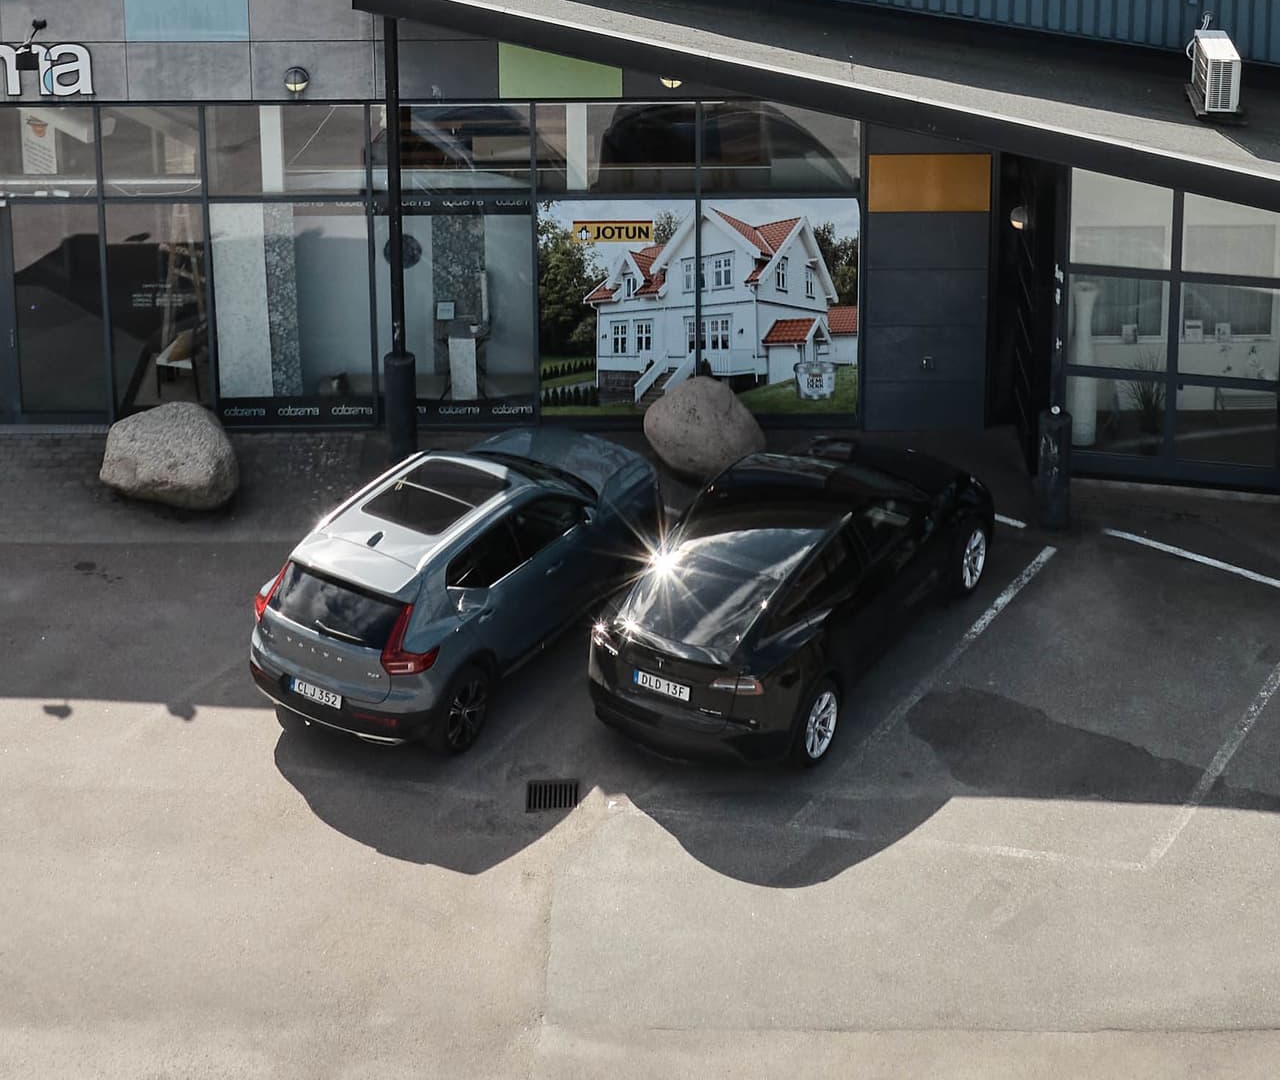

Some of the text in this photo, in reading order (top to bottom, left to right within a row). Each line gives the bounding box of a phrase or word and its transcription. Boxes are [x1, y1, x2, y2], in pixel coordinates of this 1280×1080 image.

[594, 226, 650, 240] JOTUN
[277, 404, 320, 416] colorama
[331, 404, 373, 415] colorama
[491, 403, 533, 415] colorama
[641, 674, 685, 697] DLD 13F
[297, 681, 338, 706] CLJ 352
